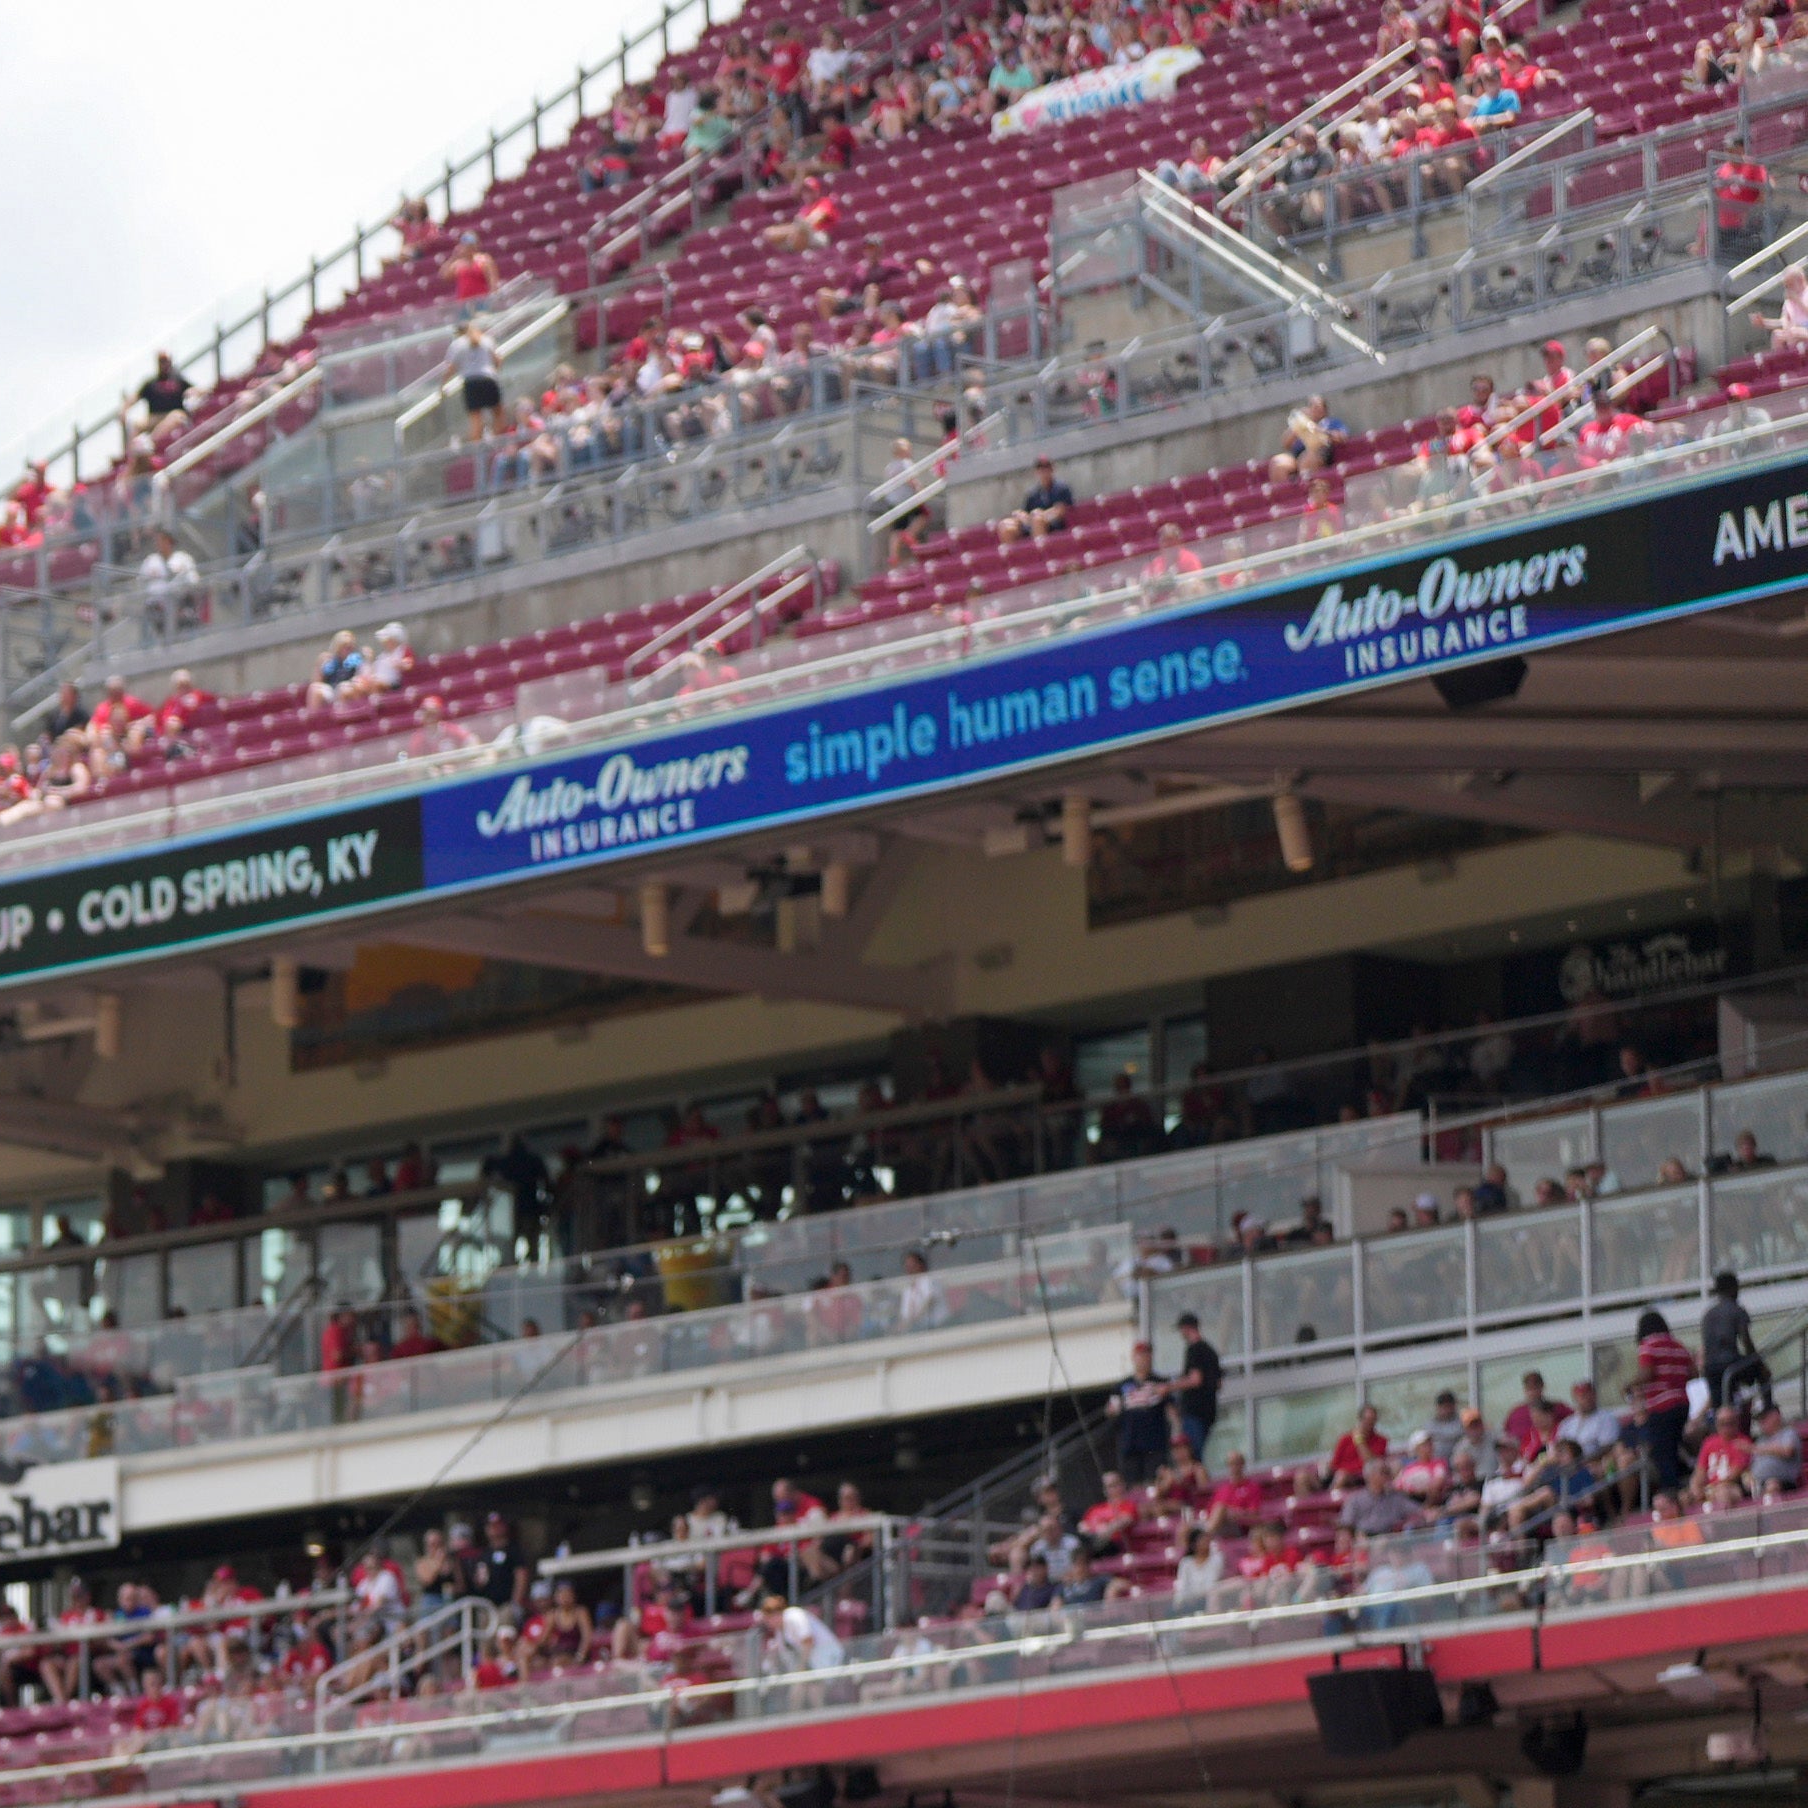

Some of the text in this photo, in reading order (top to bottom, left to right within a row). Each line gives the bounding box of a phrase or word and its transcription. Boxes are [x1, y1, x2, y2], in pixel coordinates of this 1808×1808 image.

[1284, 543, 1588, 652] Auto-Owners
[1343, 603, 1530, 678] INSURANCE
[783, 703, 938, 787] simple
[950, 674, 1100, 748] human
[476, 743, 749, 840] Auto-Owners
[530, 799, 696, 863] INSURANCE
[77, 871, 179, 936] COLD
[181, 846, 324, 917] SPRING,
[328, 828, 382, 881] KY
